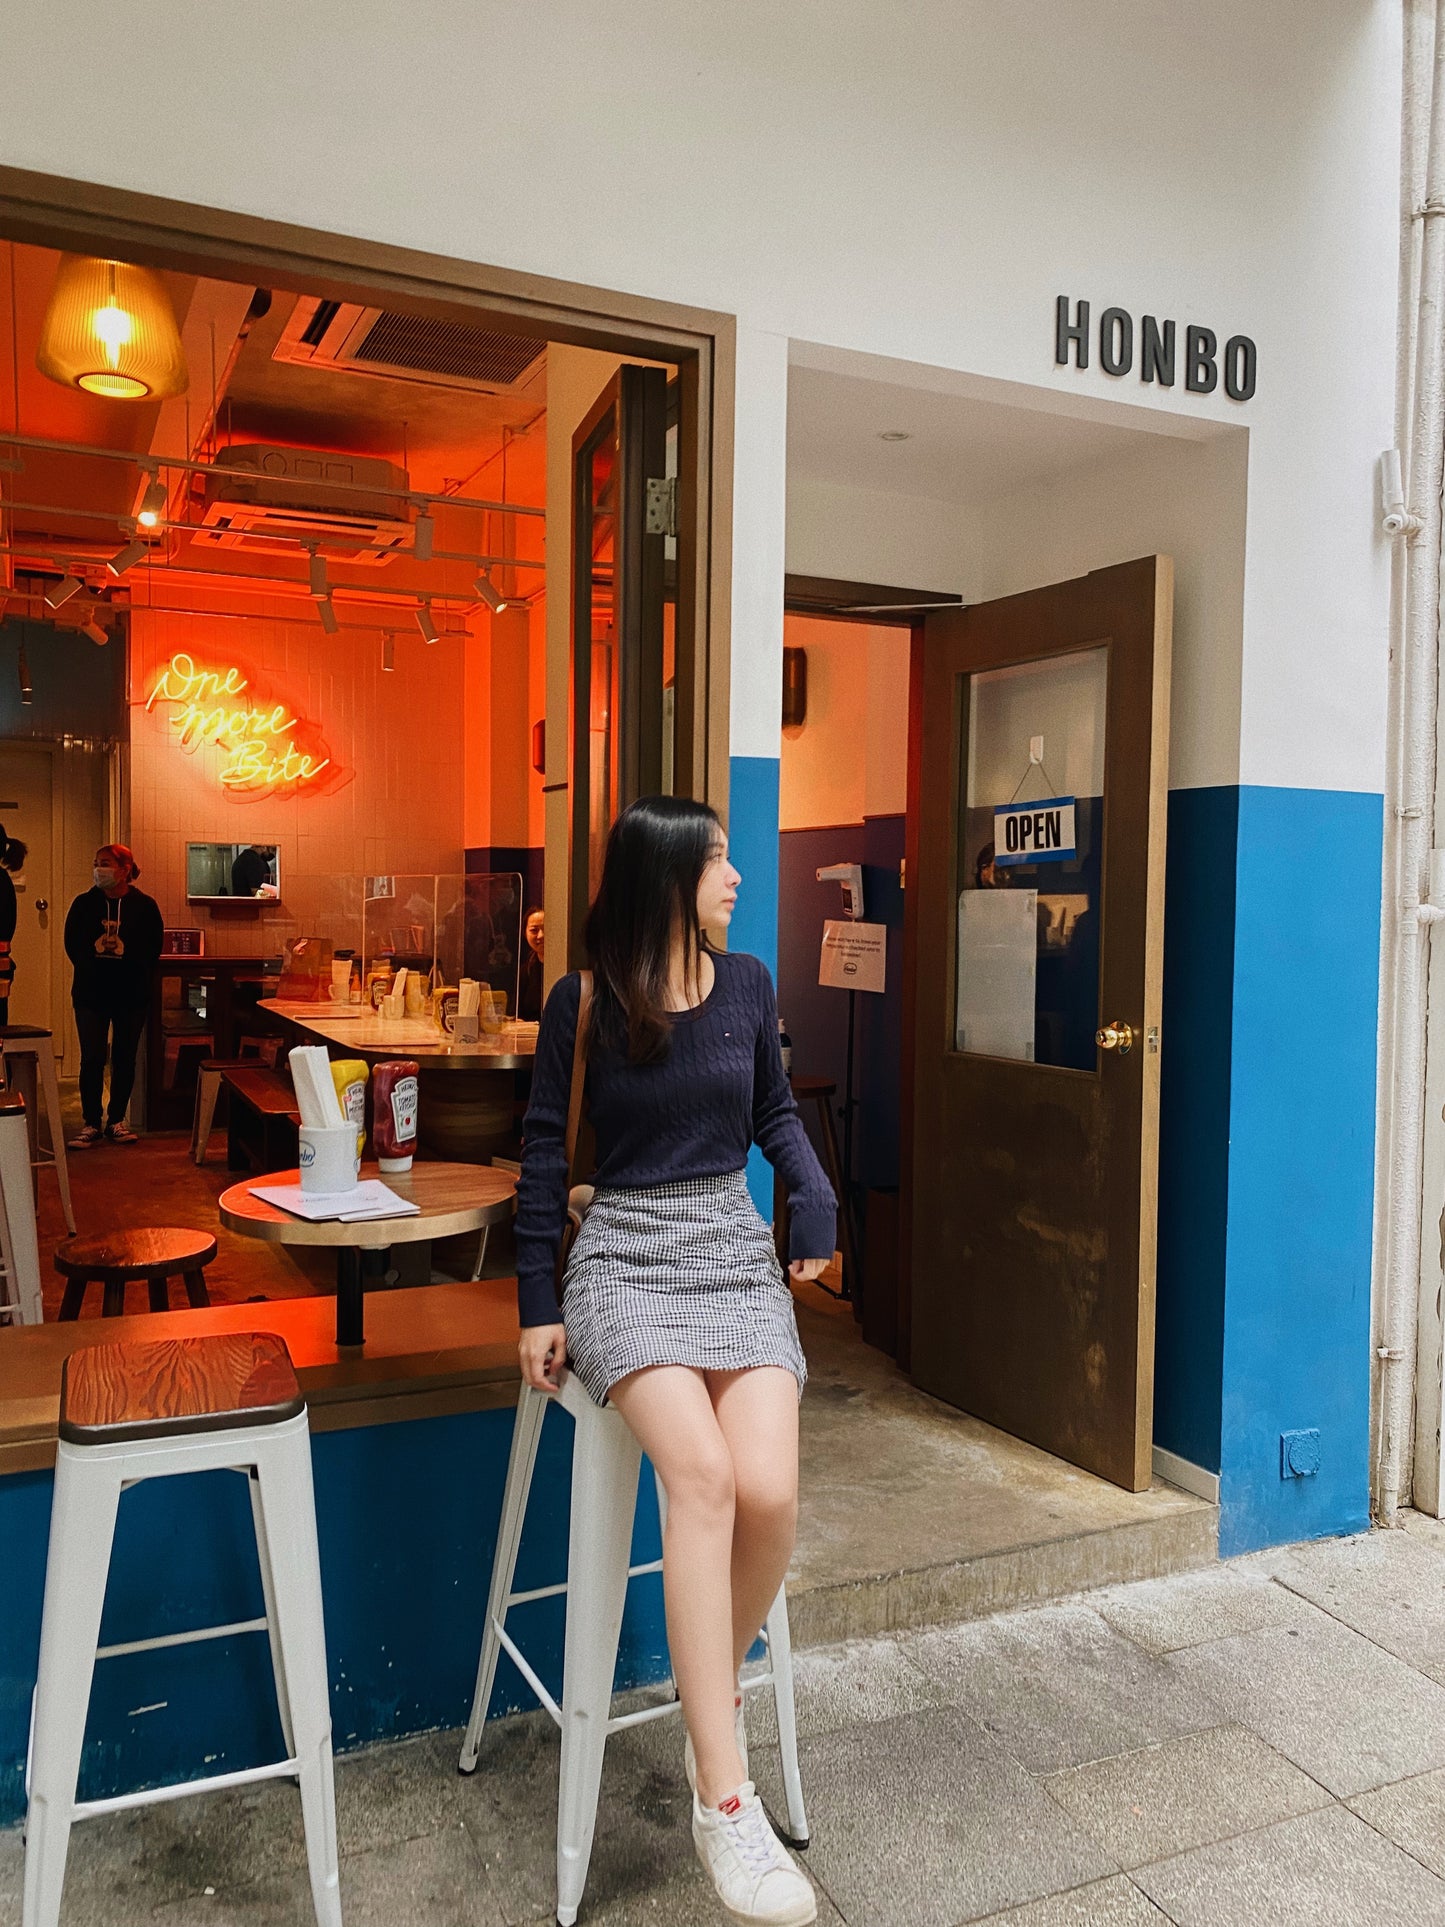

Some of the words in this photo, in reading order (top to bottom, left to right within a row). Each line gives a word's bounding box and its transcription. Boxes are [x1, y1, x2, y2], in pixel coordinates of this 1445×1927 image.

[1056, 294, 1257, 402] HONBO
[145, 653, 248, 710] One
[218, 740, 330, 783] Bite
[1005, 810, 1061, 853] OPEN
